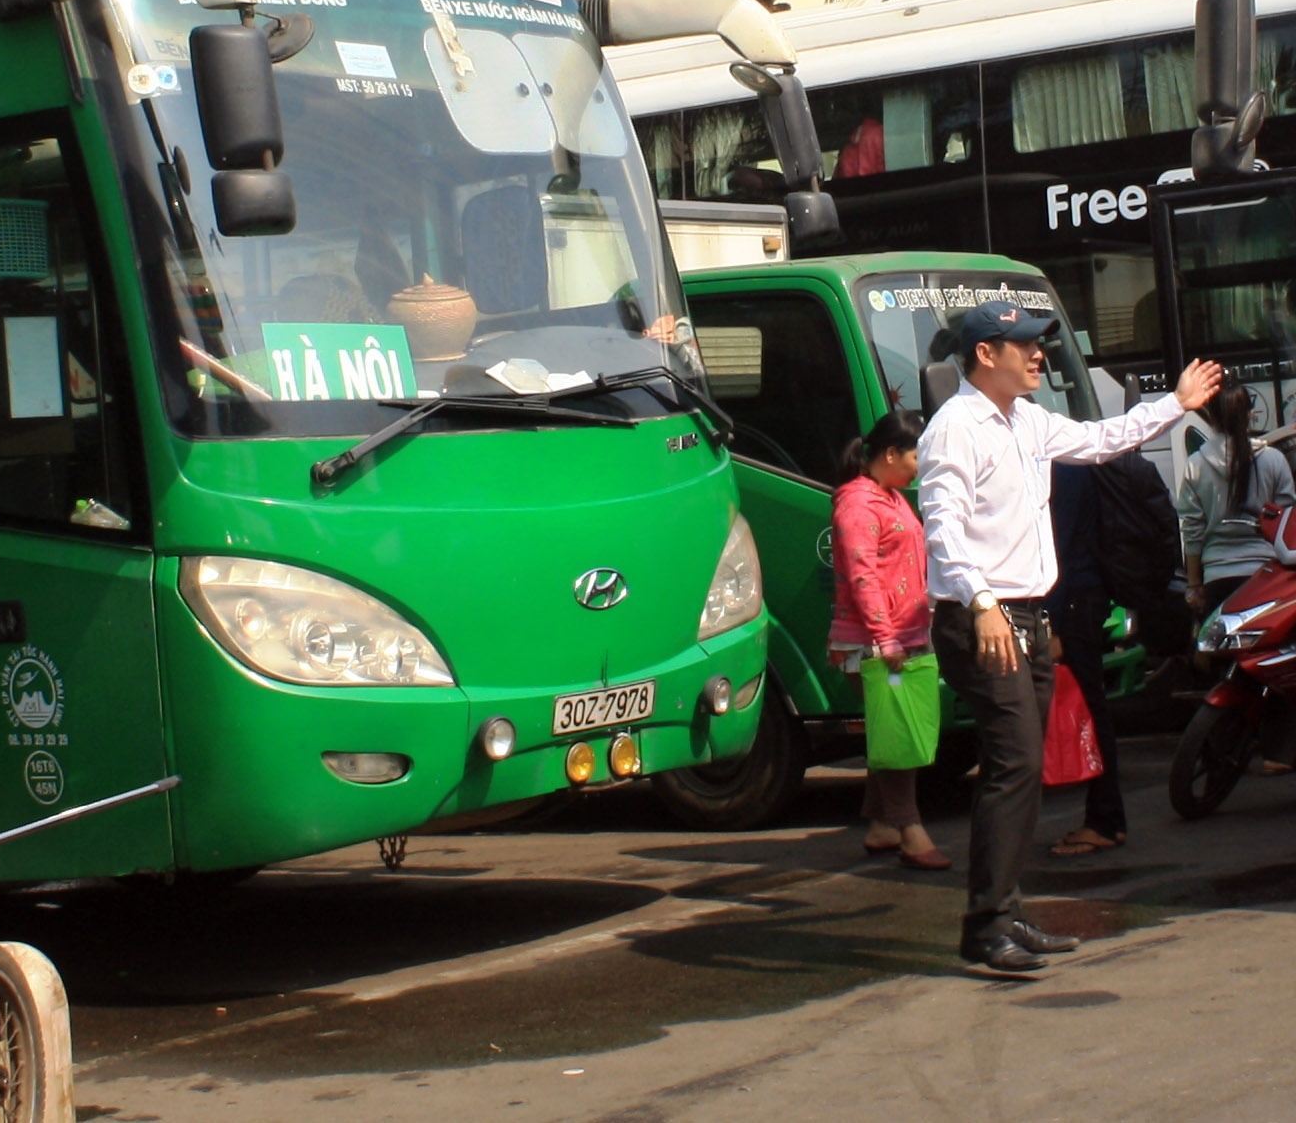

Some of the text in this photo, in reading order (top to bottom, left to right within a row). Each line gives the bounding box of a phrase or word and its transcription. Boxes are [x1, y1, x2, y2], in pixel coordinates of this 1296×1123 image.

[453, 0, 471, 17] XE
[1047, 184, 1147, 230] Free
[894, 289, 930, 311] DỊCH
[272, 334, 330, 401] HÀ
[561, 686, 648, 729] 30Z-7978
